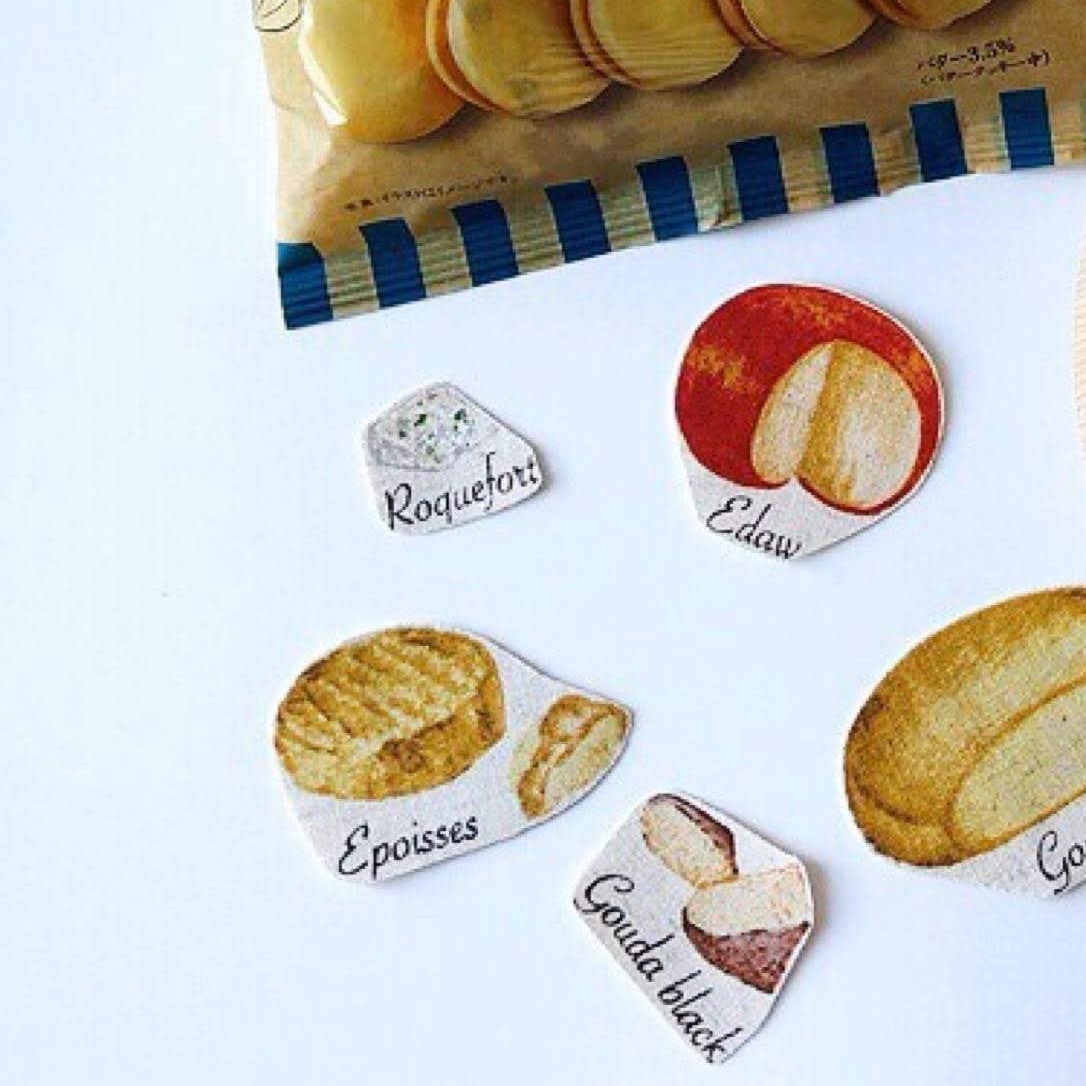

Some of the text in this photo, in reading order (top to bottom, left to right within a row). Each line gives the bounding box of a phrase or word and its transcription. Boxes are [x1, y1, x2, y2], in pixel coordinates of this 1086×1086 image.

[384, 451, 539, 531] Roquefort
[337, 814, 479, 881] Epoisses
[583, 872, 744, 1065] Gouda black
